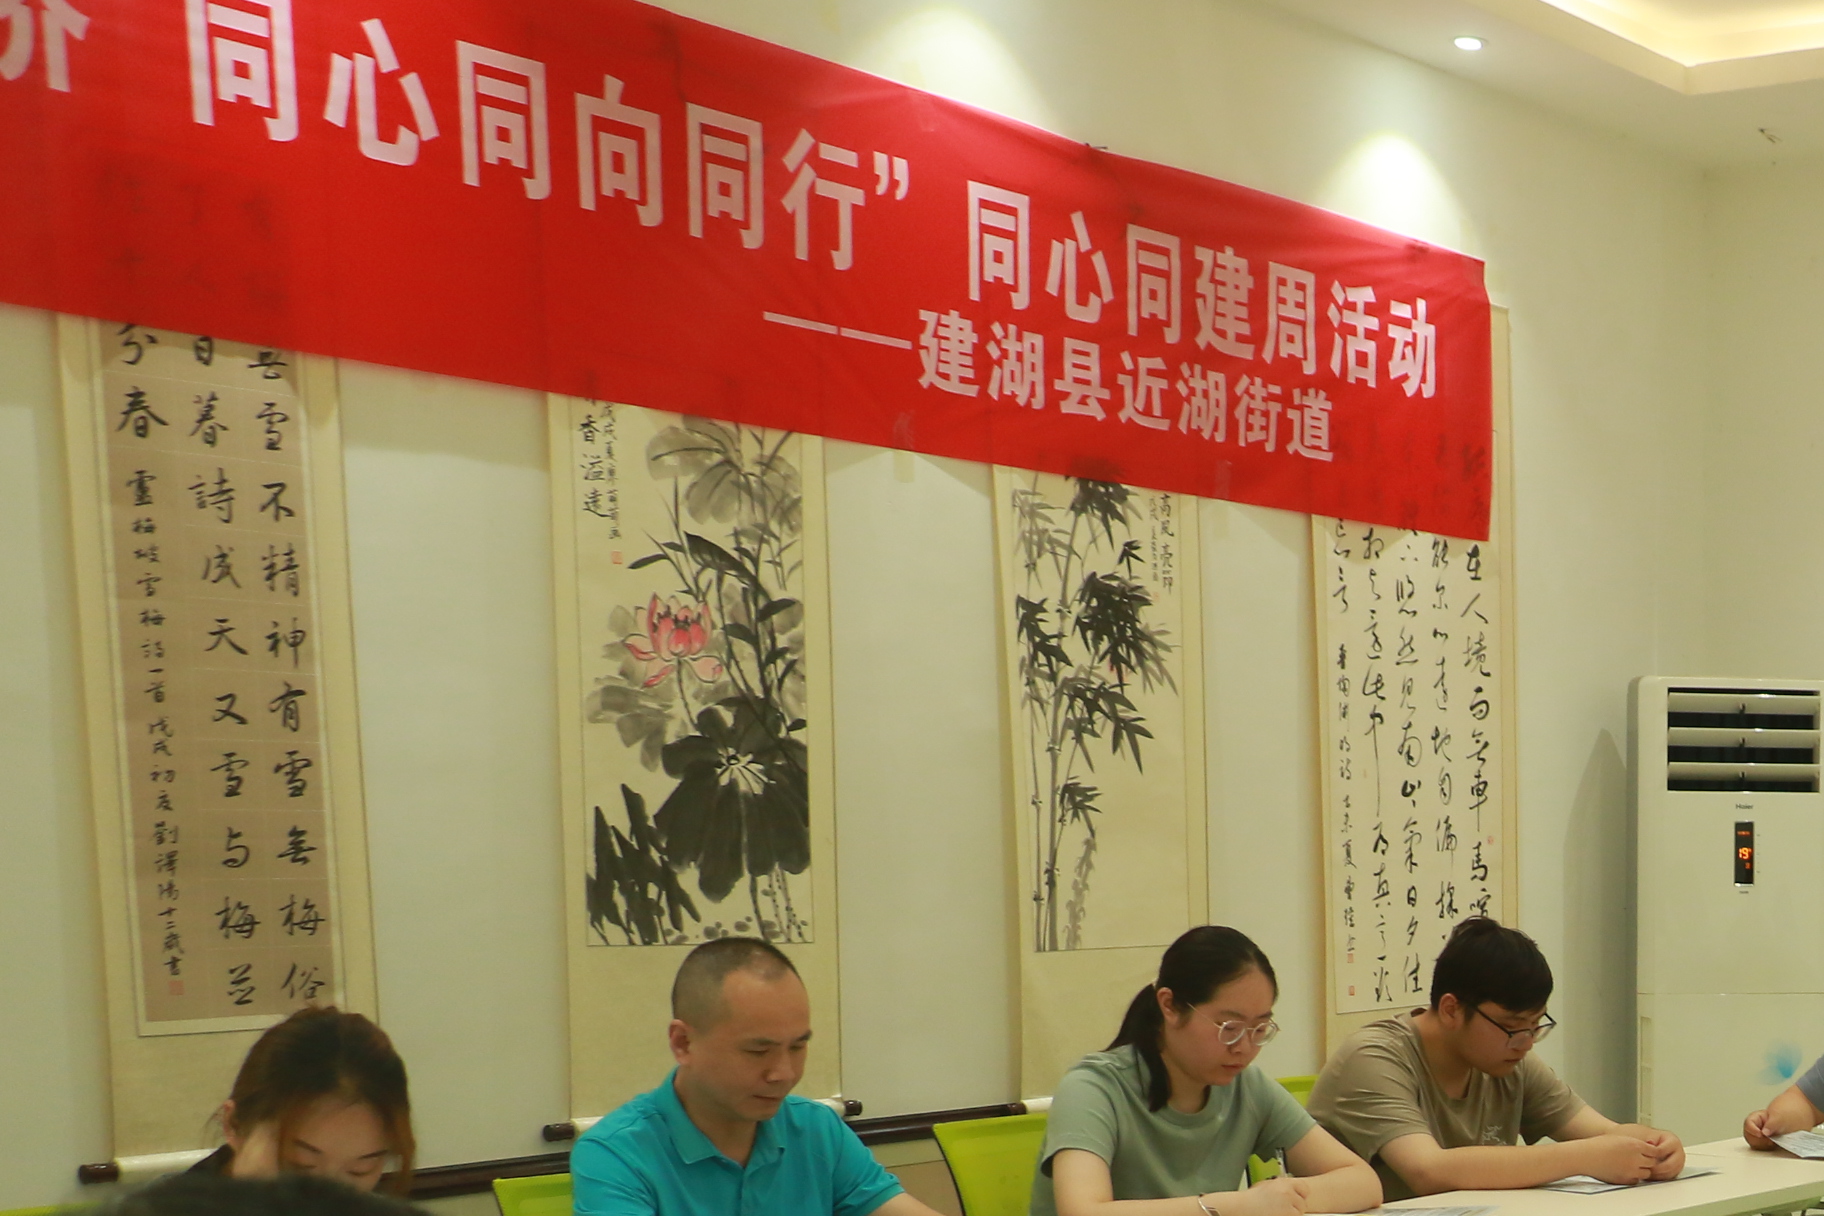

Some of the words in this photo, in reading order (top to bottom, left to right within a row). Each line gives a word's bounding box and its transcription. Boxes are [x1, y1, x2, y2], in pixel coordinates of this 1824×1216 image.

[967, 180, 1436, 400] 同心同建周活动
